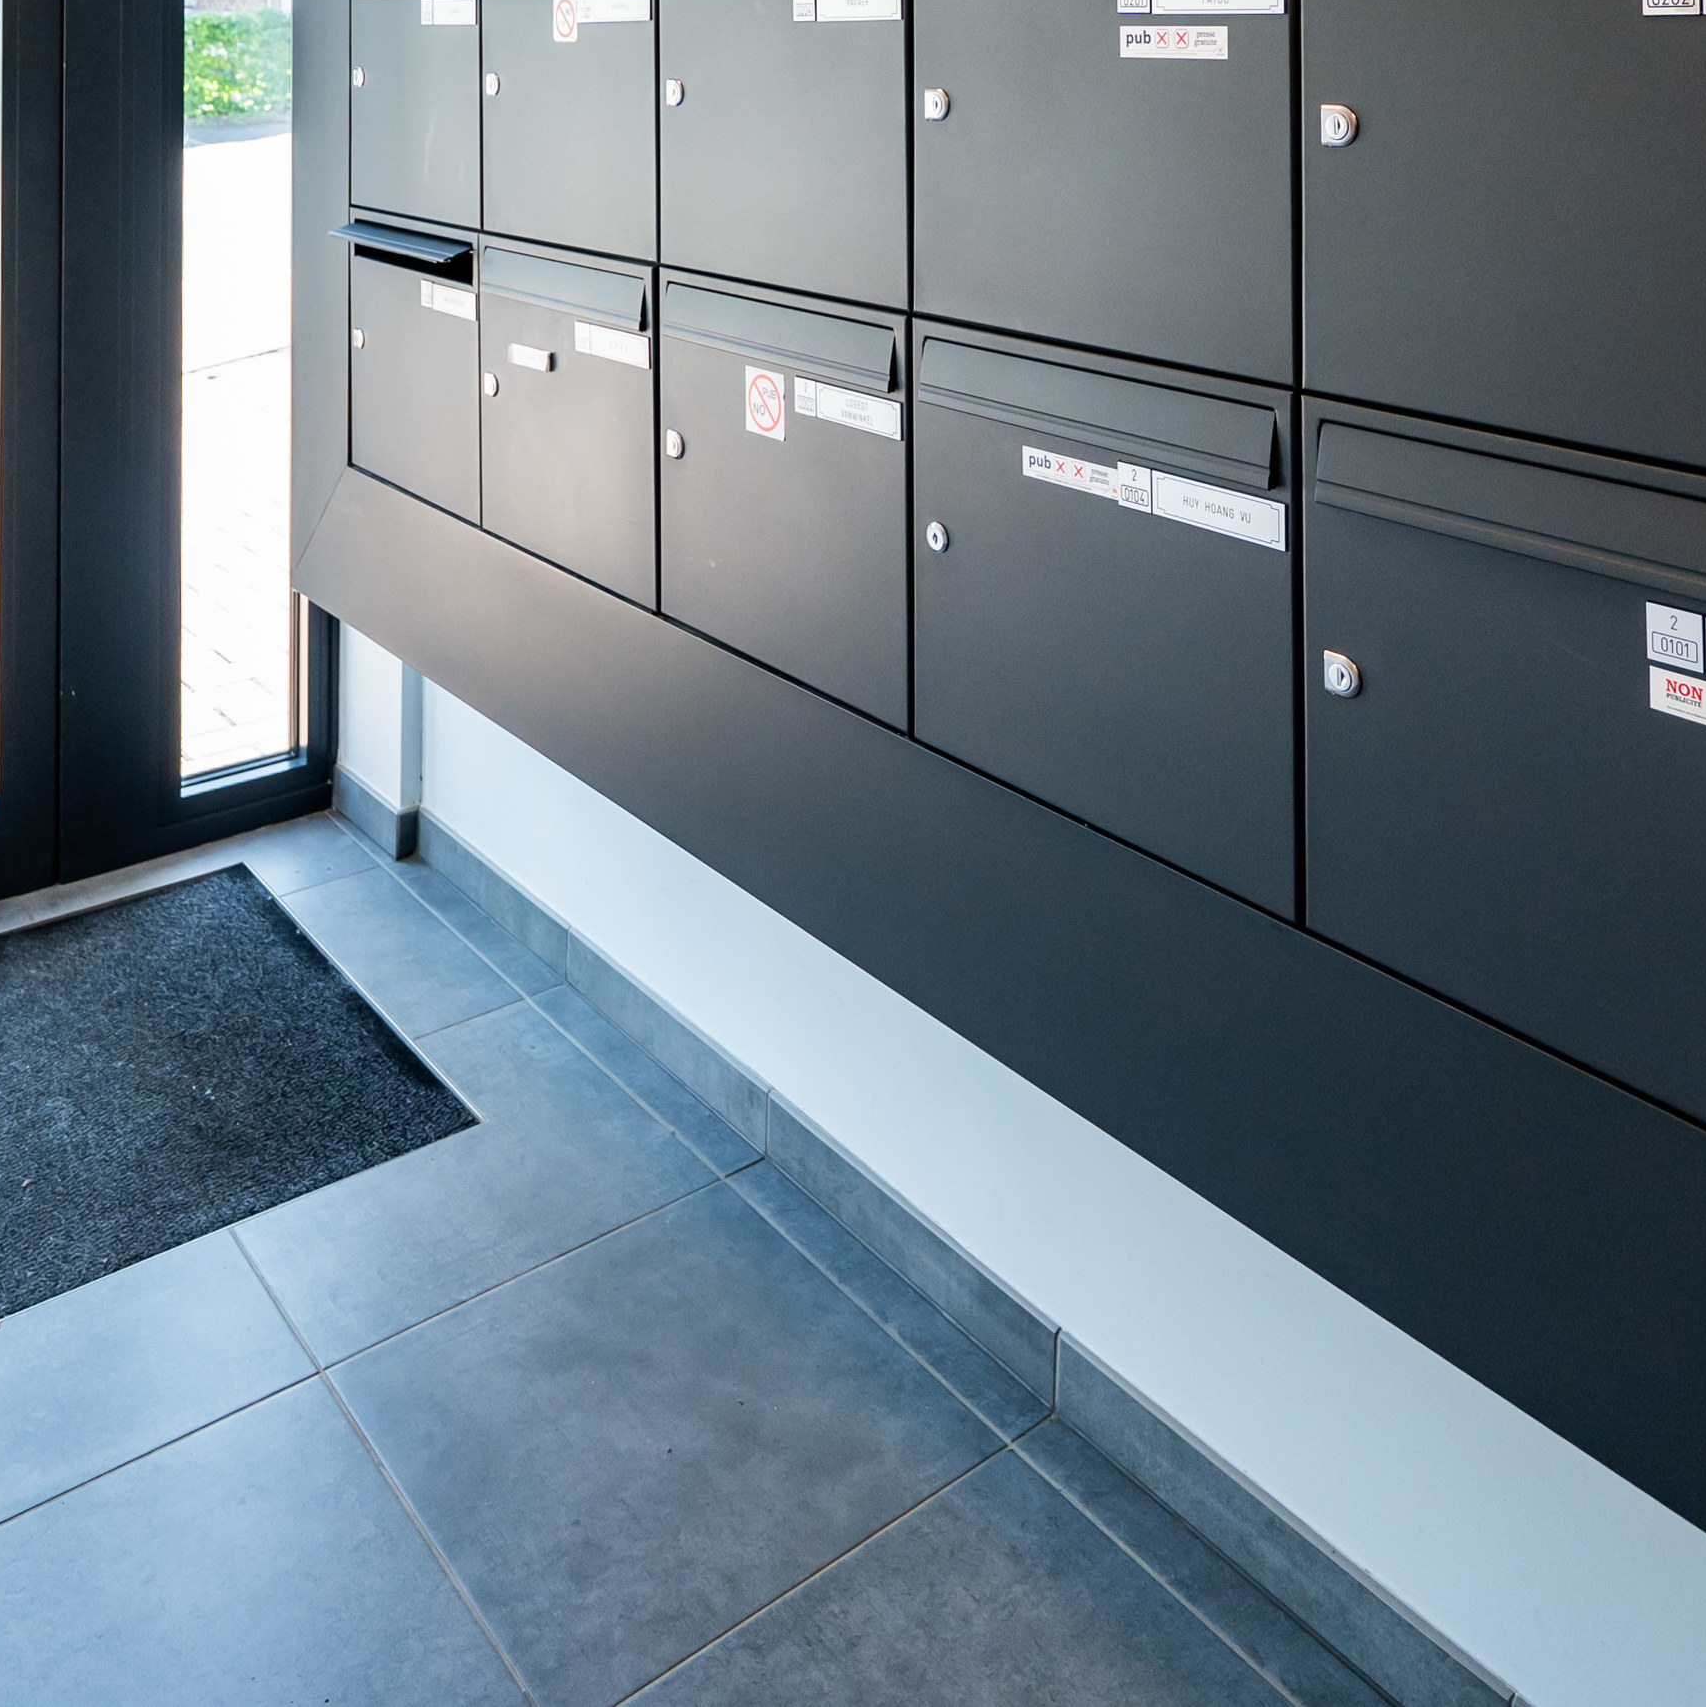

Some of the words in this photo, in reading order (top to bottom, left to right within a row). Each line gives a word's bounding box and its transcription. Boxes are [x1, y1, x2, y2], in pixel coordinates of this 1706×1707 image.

[1126, 30, 1152, 47] pub
[762, 387, 776, 400] PUB
[753, 402, 766, 416] NO
[1029, 455, 1051, 470] pub
[1131, 469, 1137, 481] 2
[1124, 487, 1145, 503] 0104
[1183, 496, 1200, 509] HUY
[1205, 502, 1235, 519] HOANG
[1240, 511, 1251, 524] VU
[1670, 615, 1678, 631] 2
[1661, 636, 1689, 658] 0101
[1666, 678, 1703, 702] NON
